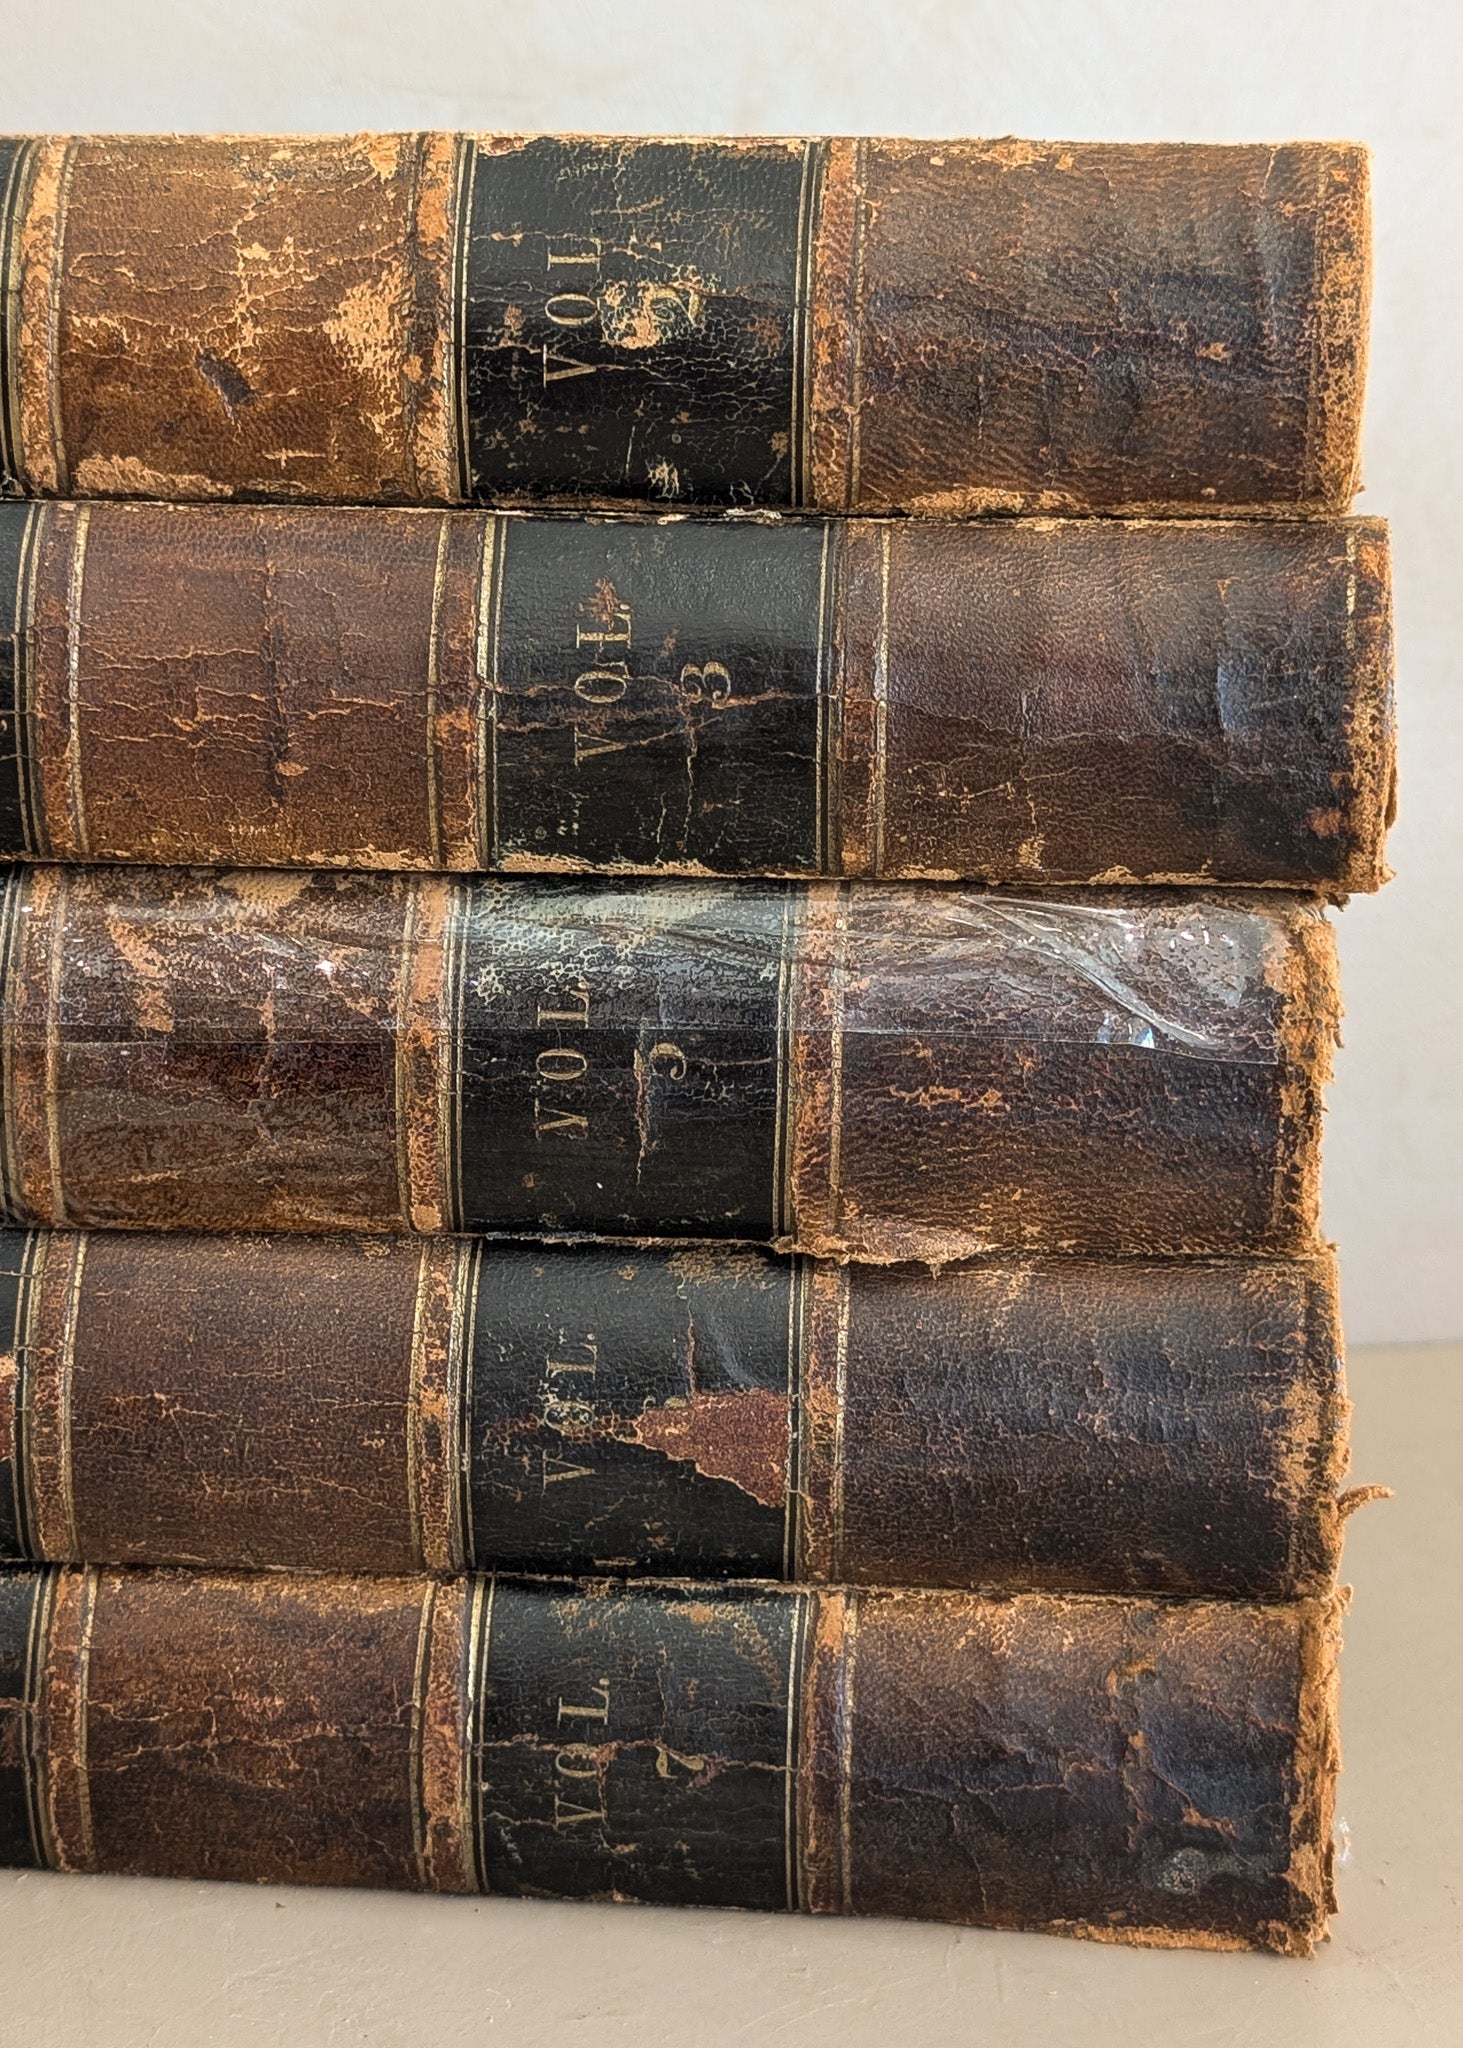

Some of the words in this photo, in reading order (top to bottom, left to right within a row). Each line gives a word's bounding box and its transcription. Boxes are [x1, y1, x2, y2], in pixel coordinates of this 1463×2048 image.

[645, 283, 704, 329] 2
[680, 660, 732, 702] 3
[633, 1042, 687, 1081] 5
[542, 1332, 599, 1496] VOL.
[555, 1677, 611, 1828] VOL.
[655, 1743, 705, 1779] 7
